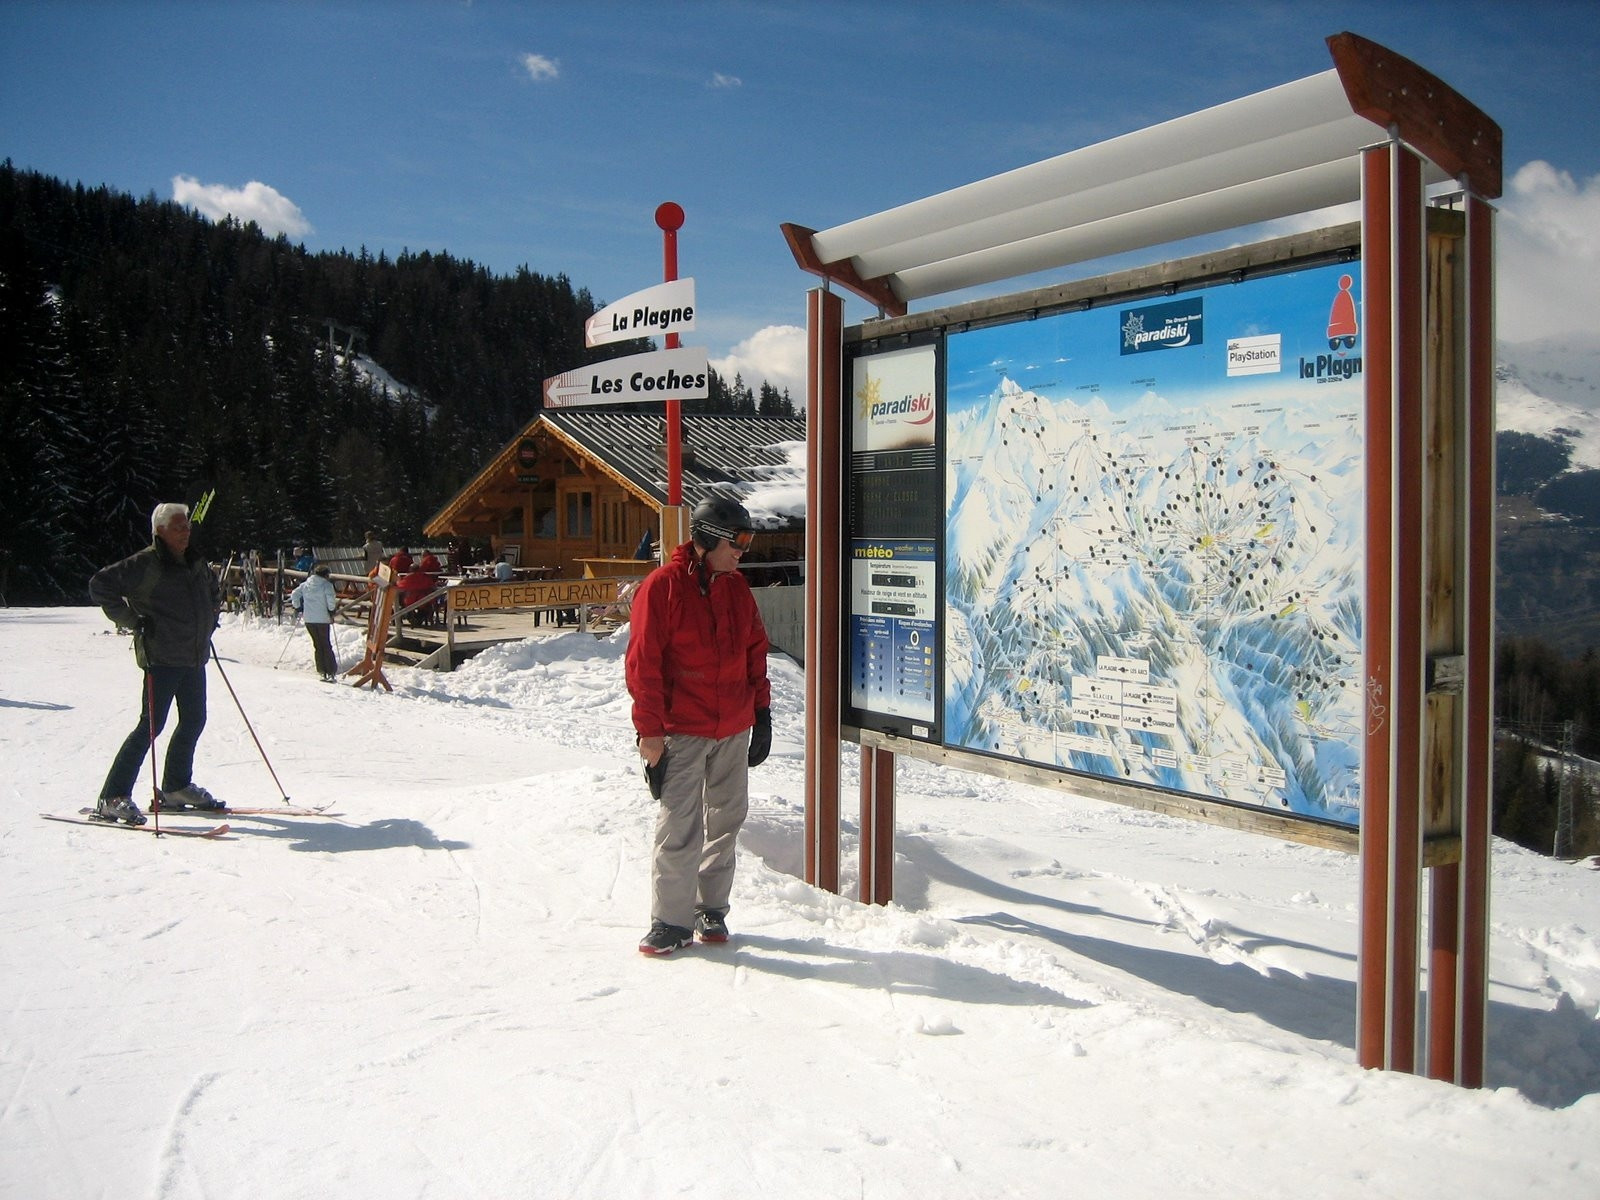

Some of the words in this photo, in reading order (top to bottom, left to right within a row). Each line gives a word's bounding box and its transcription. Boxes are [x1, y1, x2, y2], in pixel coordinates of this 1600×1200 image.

[612, 313, 628, 331] La
[632, 306, 694, 329] Plagne
[1134, 322, 1188, 345] paradiski
[1300, 357, 1315, 379] la
[1316, 354, 1362, 379] Plagn
[591, 375, 623, 394] Les
[630, 369, 706, 392] Coches
[871, 392, 931, 420] paradiski
[855, 544, 893, 558] météo
[500, 583, 613, 605] RESTAURANT
